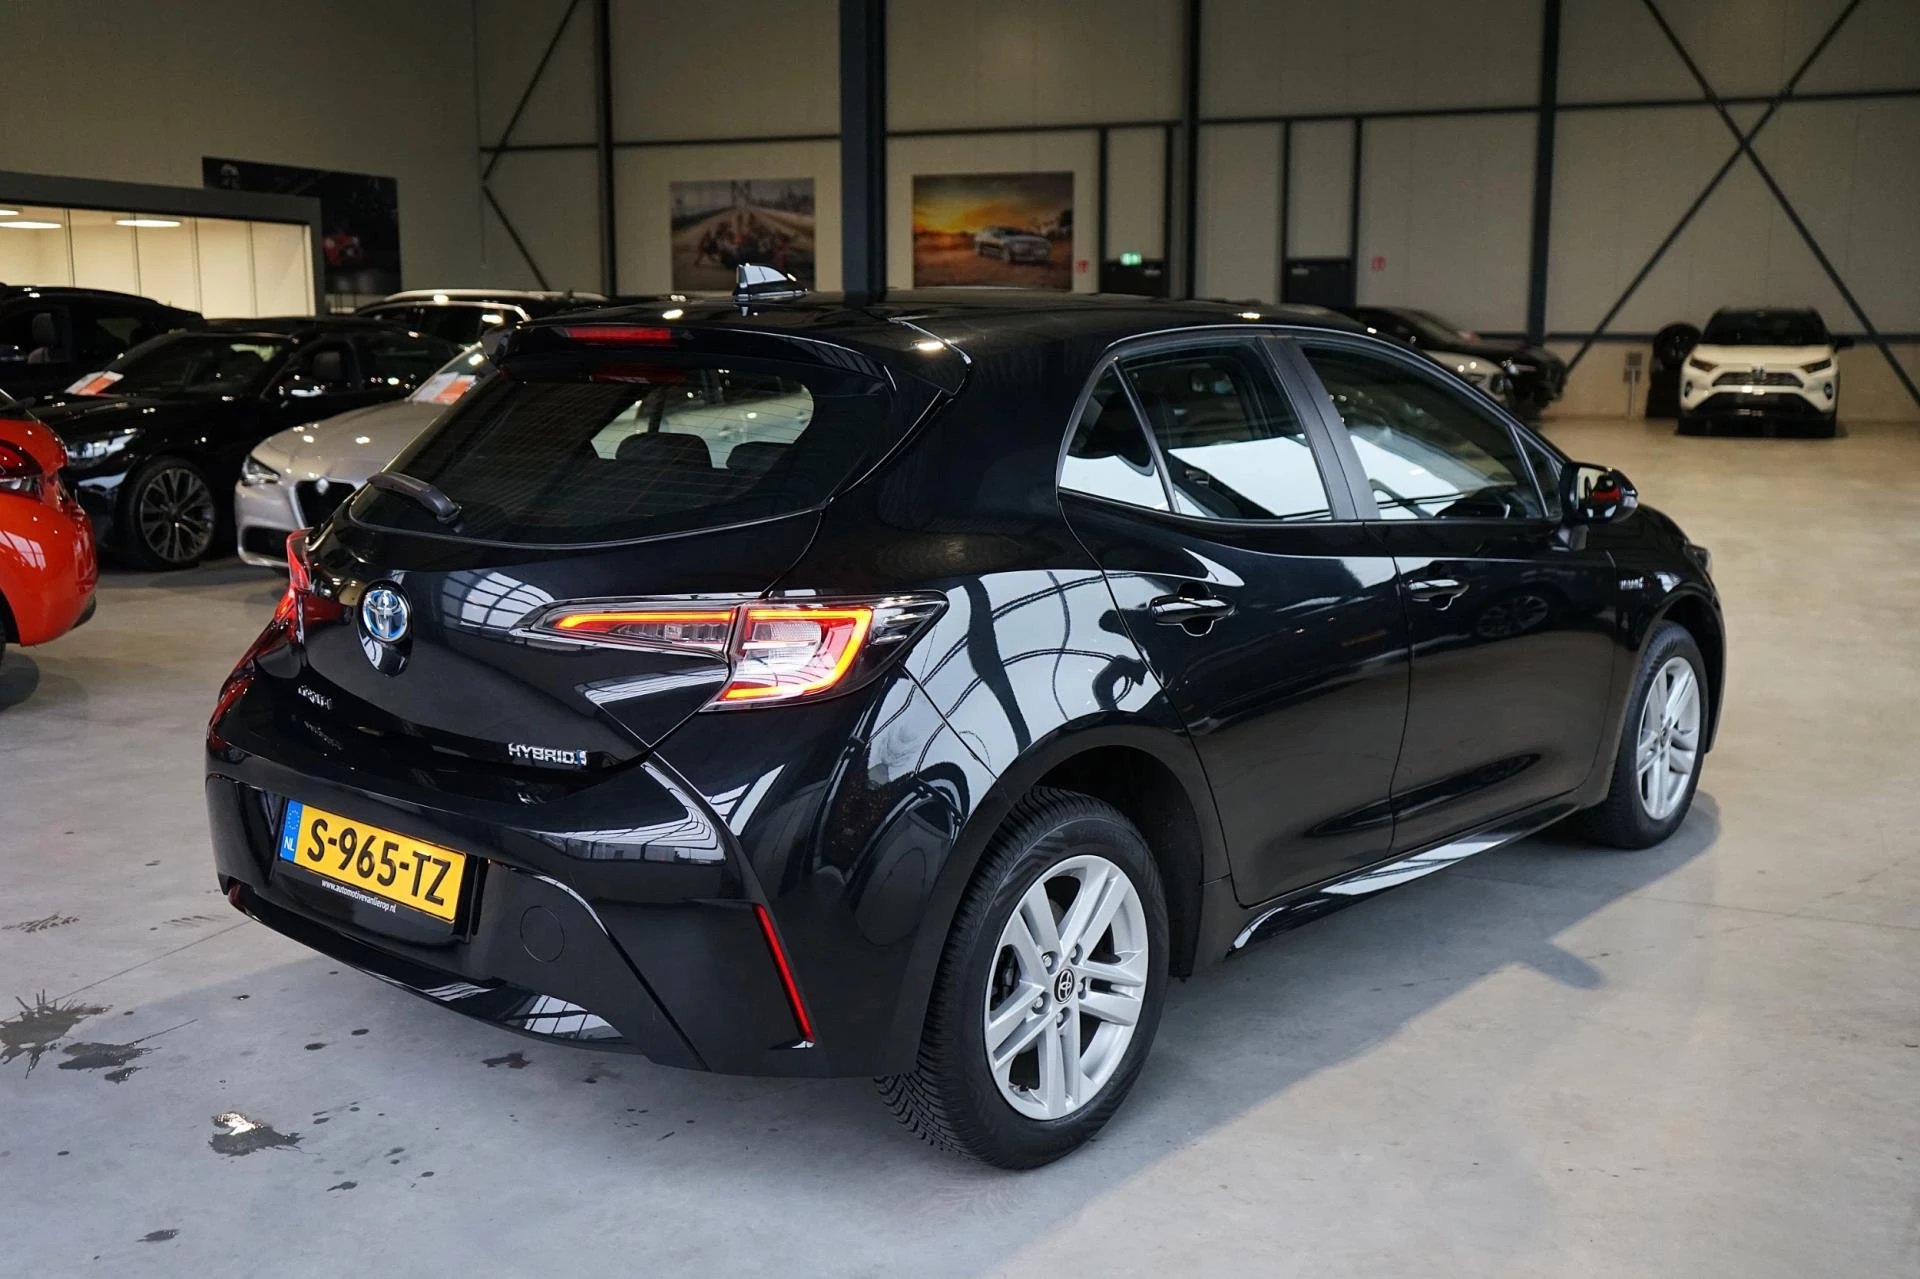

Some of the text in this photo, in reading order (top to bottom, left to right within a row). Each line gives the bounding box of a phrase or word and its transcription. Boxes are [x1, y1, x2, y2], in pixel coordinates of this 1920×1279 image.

[508, 743, 575, 765] HYBRID
[284, 838, 295, 851] NL
[307, 818, 451, 906] S-965-TZ
